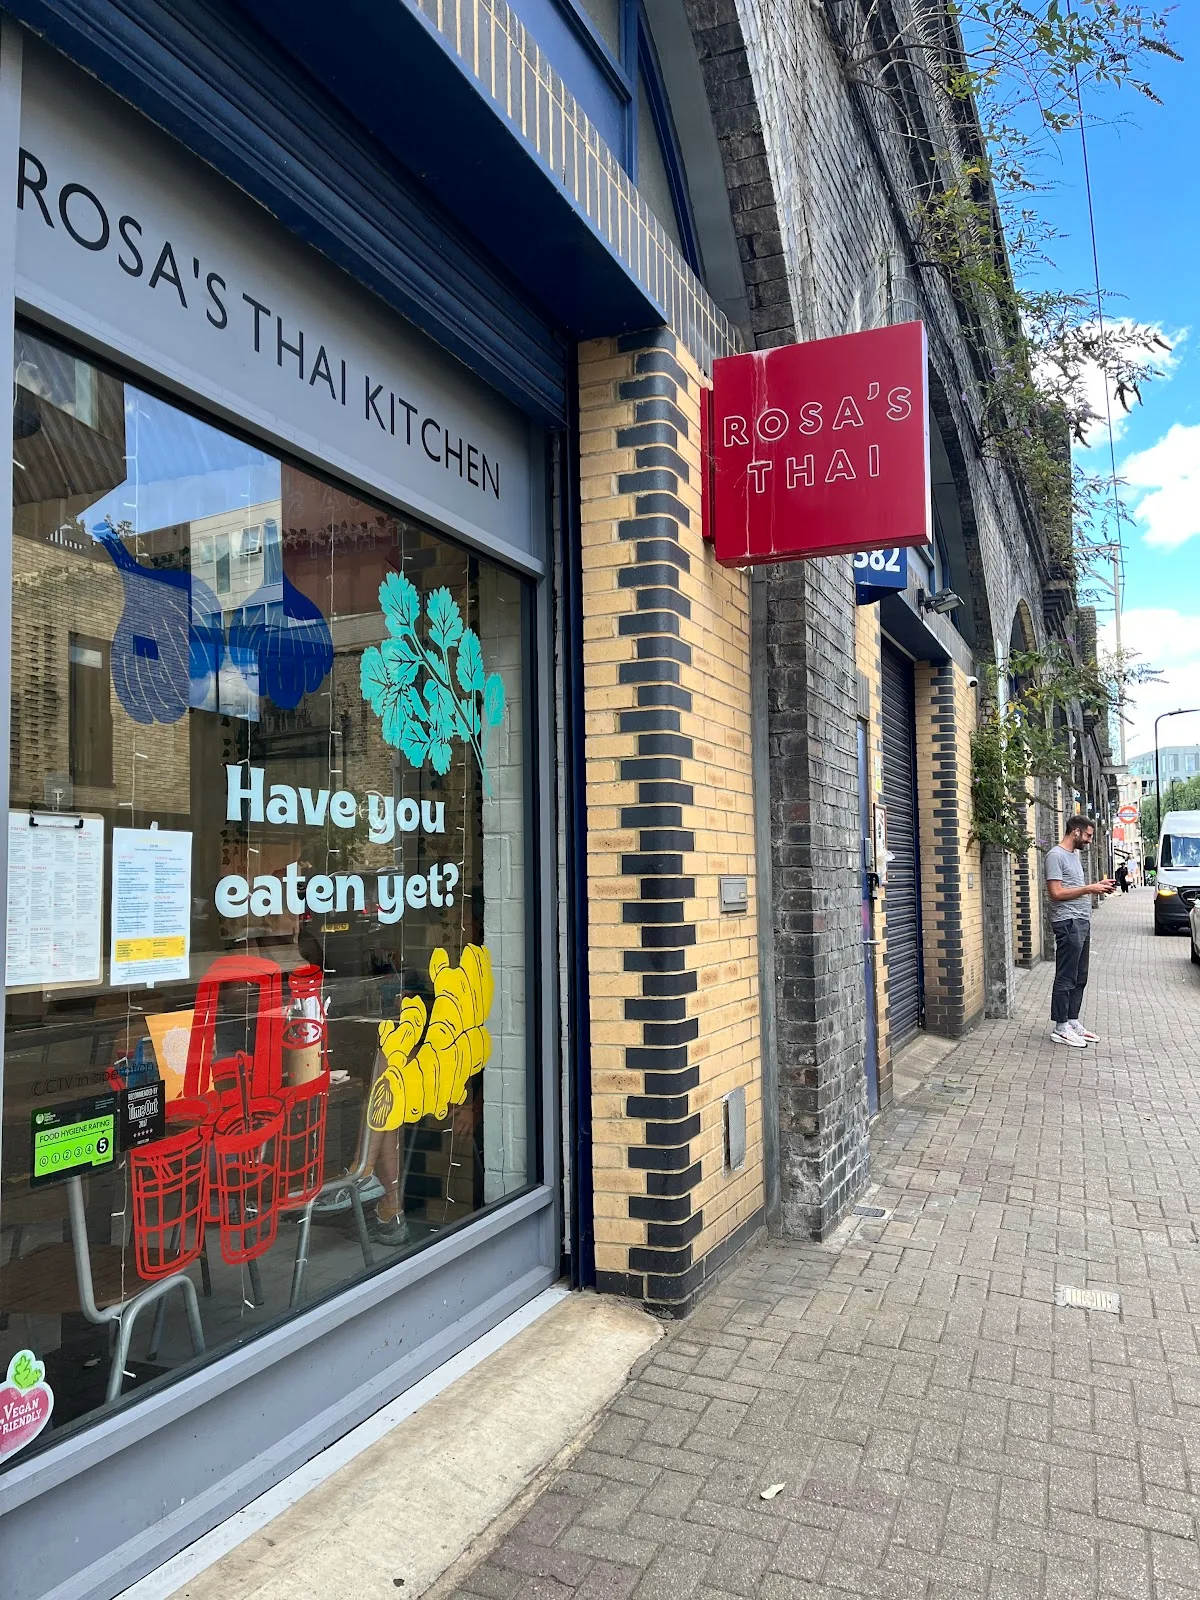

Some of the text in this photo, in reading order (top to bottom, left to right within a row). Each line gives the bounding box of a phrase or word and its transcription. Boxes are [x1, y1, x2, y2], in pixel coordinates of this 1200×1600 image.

[17, 147, 502, 500] ROSA'S THAI KITCHEN
[723, 382, 912, 447] ROSA'S
[747, 445, 880, 494] THAI
[225, 764, 446, 845] Have you
[215, 862, 375, 918] eaten
[378, 862, 459, 924] yet?
[33, 1061, 154, 1097] CCTV in operation
[128, 1088, 153, 1101] RECOMMENDED
[39, 1119, 110, 1143] FOOD HYGIENE RATING
[3, 1397, 39, 1421] VEGAN
